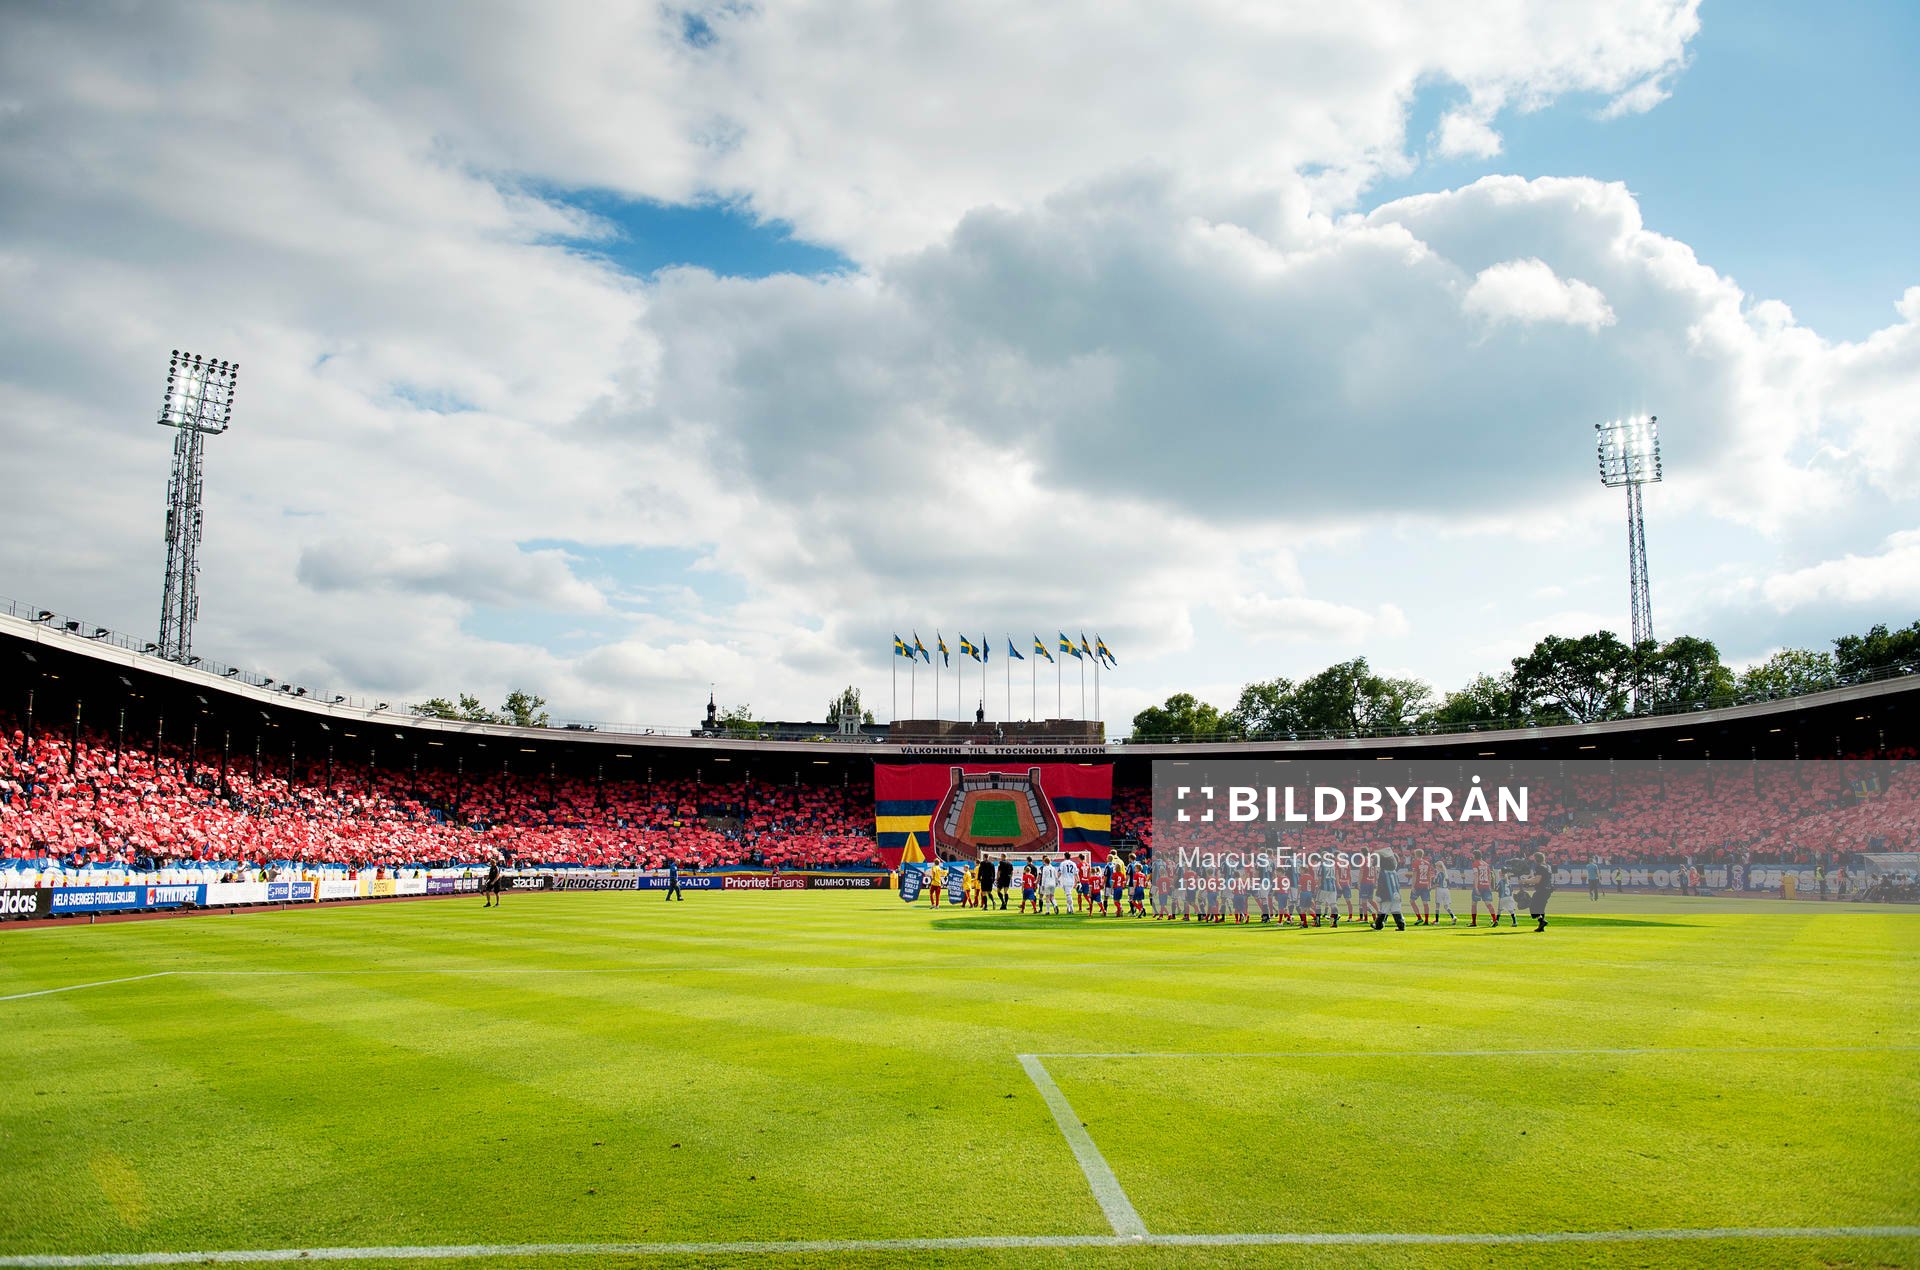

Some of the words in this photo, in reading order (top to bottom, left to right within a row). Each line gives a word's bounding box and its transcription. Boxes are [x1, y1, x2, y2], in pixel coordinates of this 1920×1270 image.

[1066, 864, 1074, 874] 12
[512, 876, 545, 888] stadium
[553, 877, 638, 889] BRIDGESTONE
[649, 877, 710, 887] Nilfik-ALTO
[725, 877, 770, 888] Prioritet
[771, 877, 804, 888] Finans
[814, 878, 845, 887] KUMHO
[845, 878, 871, 887] TYRES
[0, 890, 38, 913] didas
[53, 893, 69, 906] HELA
[69, 892, 95, 906] SVERIGES
[94, 891, 136, 904] FOTBOLLSKLUBB
